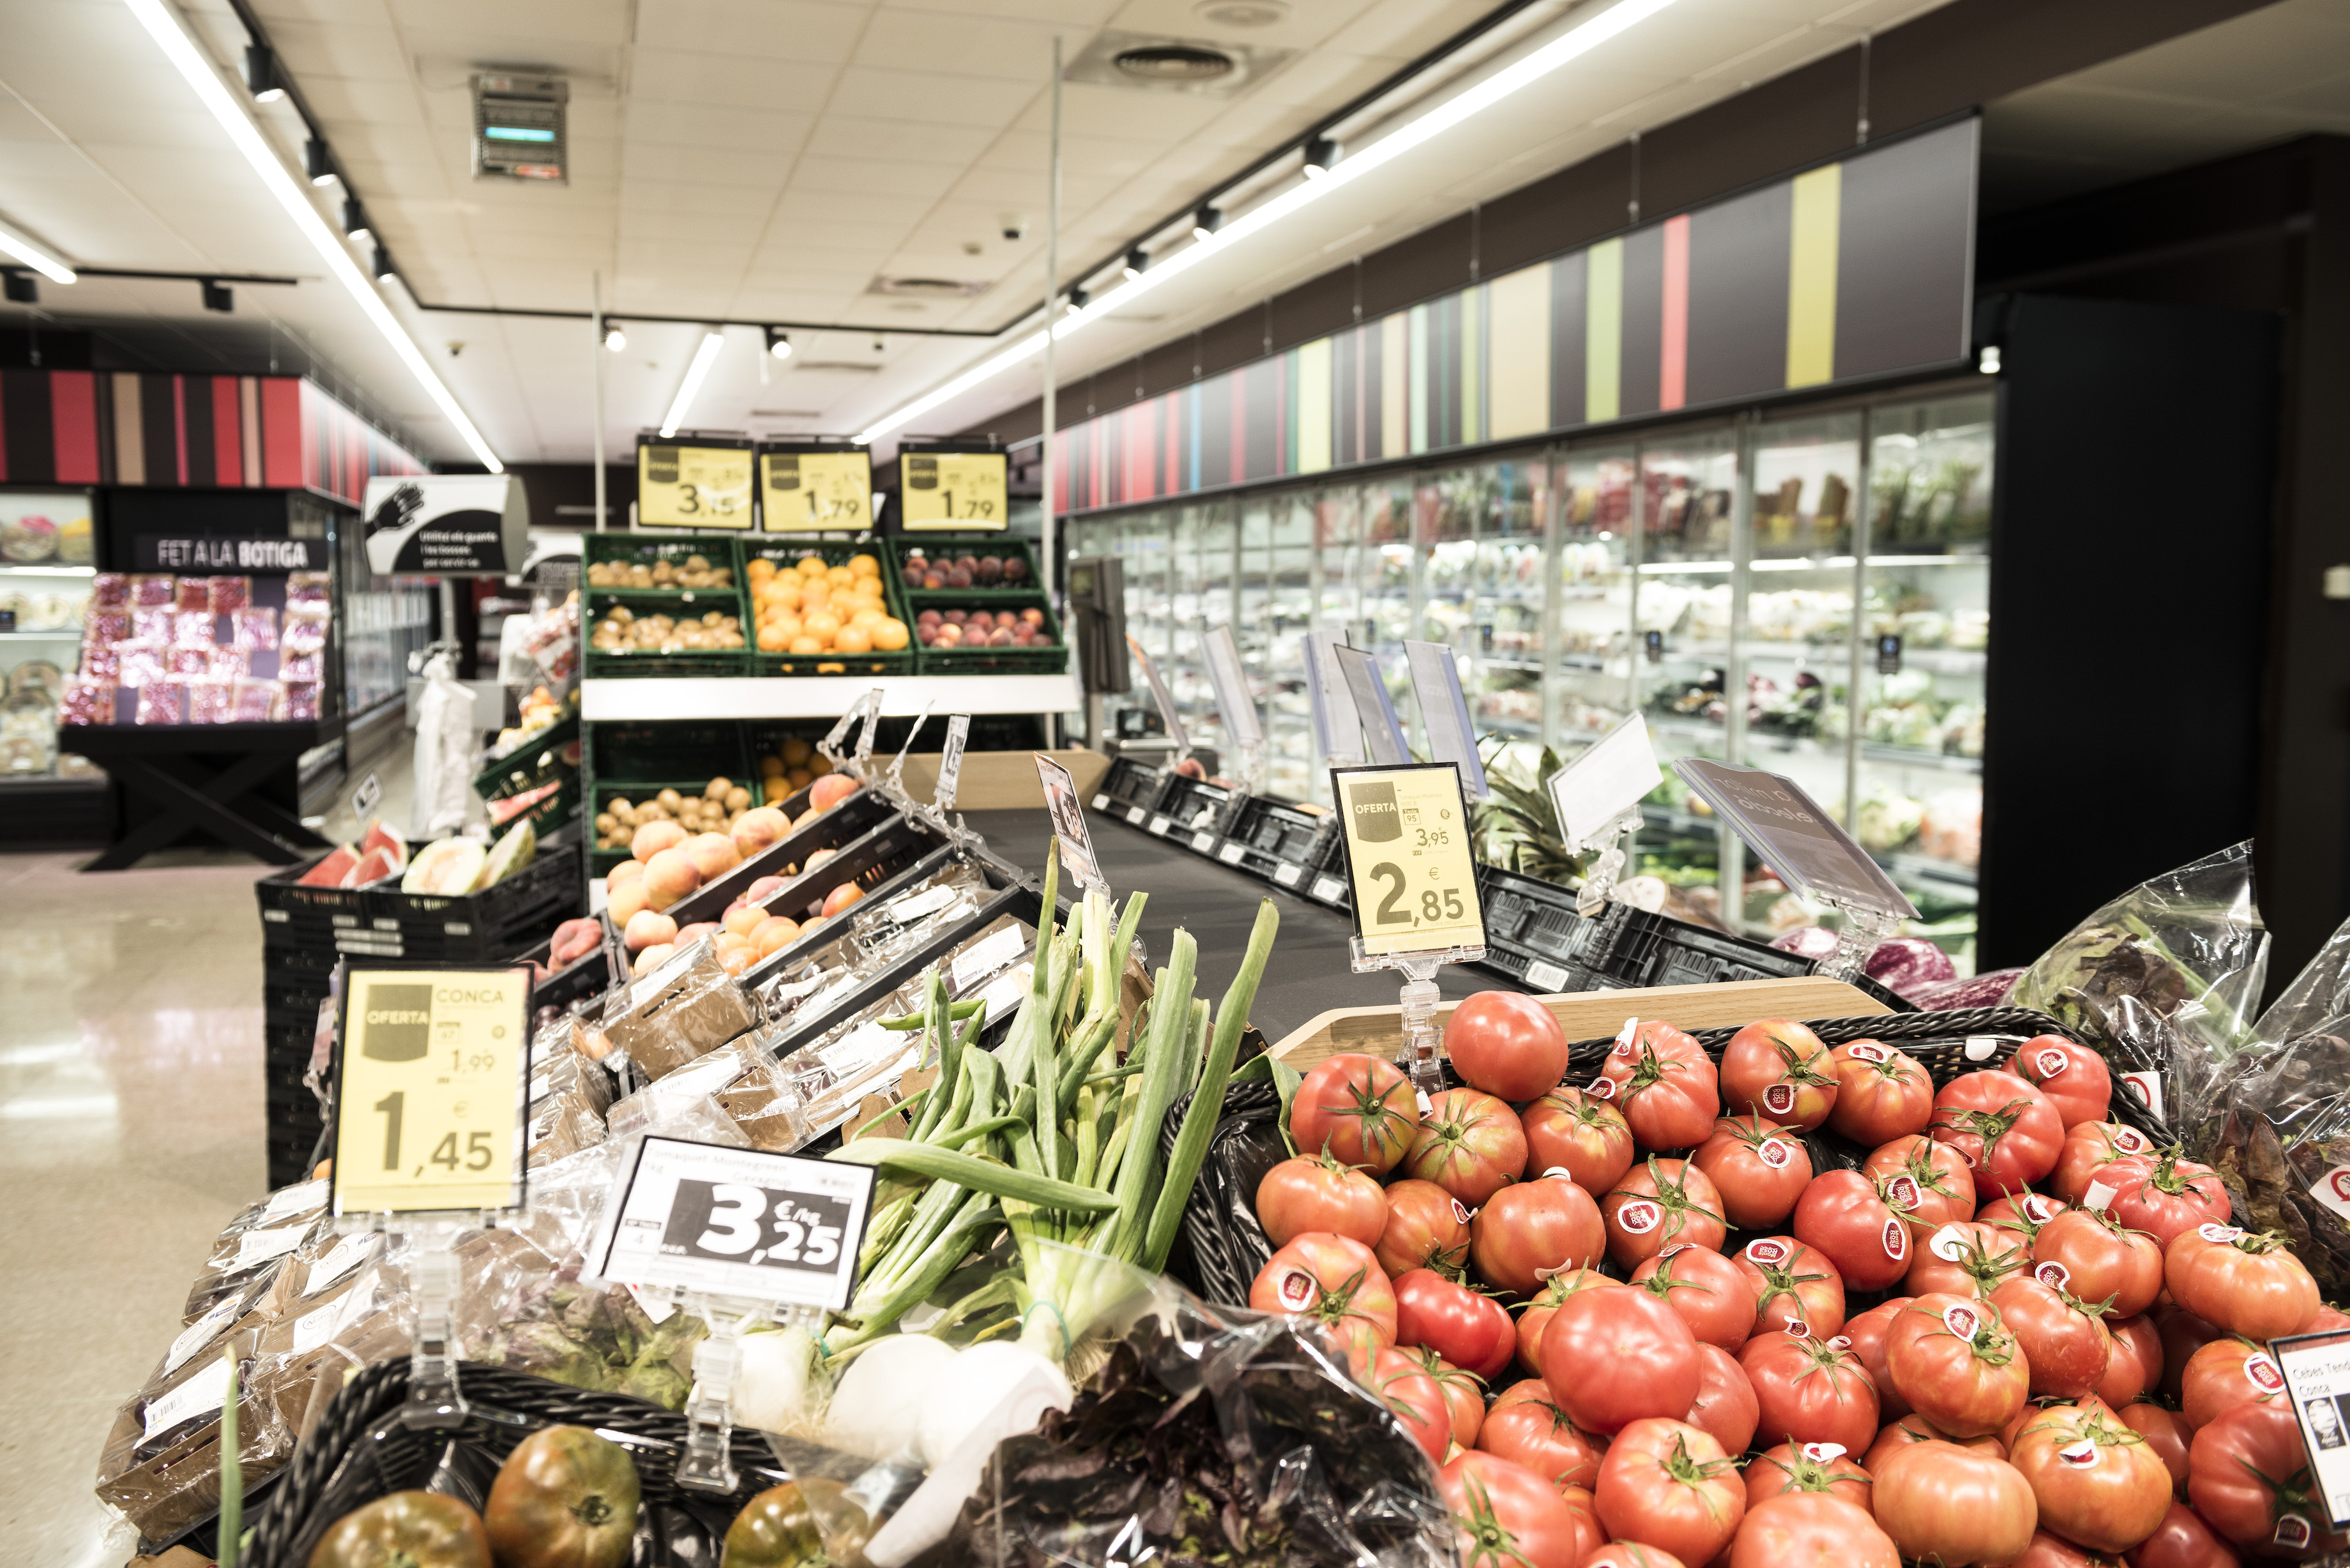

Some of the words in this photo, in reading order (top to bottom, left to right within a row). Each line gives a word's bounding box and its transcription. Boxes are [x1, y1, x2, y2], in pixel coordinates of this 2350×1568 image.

[942, 490, 994, 519] 1,79
[158, 540, 192, 567] FET
[193, 540, 209, 567] A
[210, 541, 236, 567] LA
[238, 541, 309, 568] BOTIGA
[1355, 802, 1397, 814] OFERTA
[1416, 828, 1449, 848] 3,95
[1429, 867, 1439, 880] €
[1369, 862, 1464, 928] 2,85
[437, 990, 503, 1003] CONCA
[366, 1010, 428, 1024] OFERTA
[451, 1050, 495, 1074] 1,99
[374, 1091, 493, 1178] 1,45
[1766, 1147, 1777, 1157] Monte
[1904, 1184, 1913, 1201] Monte
[1629, 1209, 1647, 1217] Monte
[696, 1184, 841, 1265] 3,25
[1961, 1316, 1970, 1332] Monte
[2259, 1363, 2277, 1382] Monte
[2325, 1359, 2350, 1374] Tend
[2300, 1384, 2330, 1397] Conca
